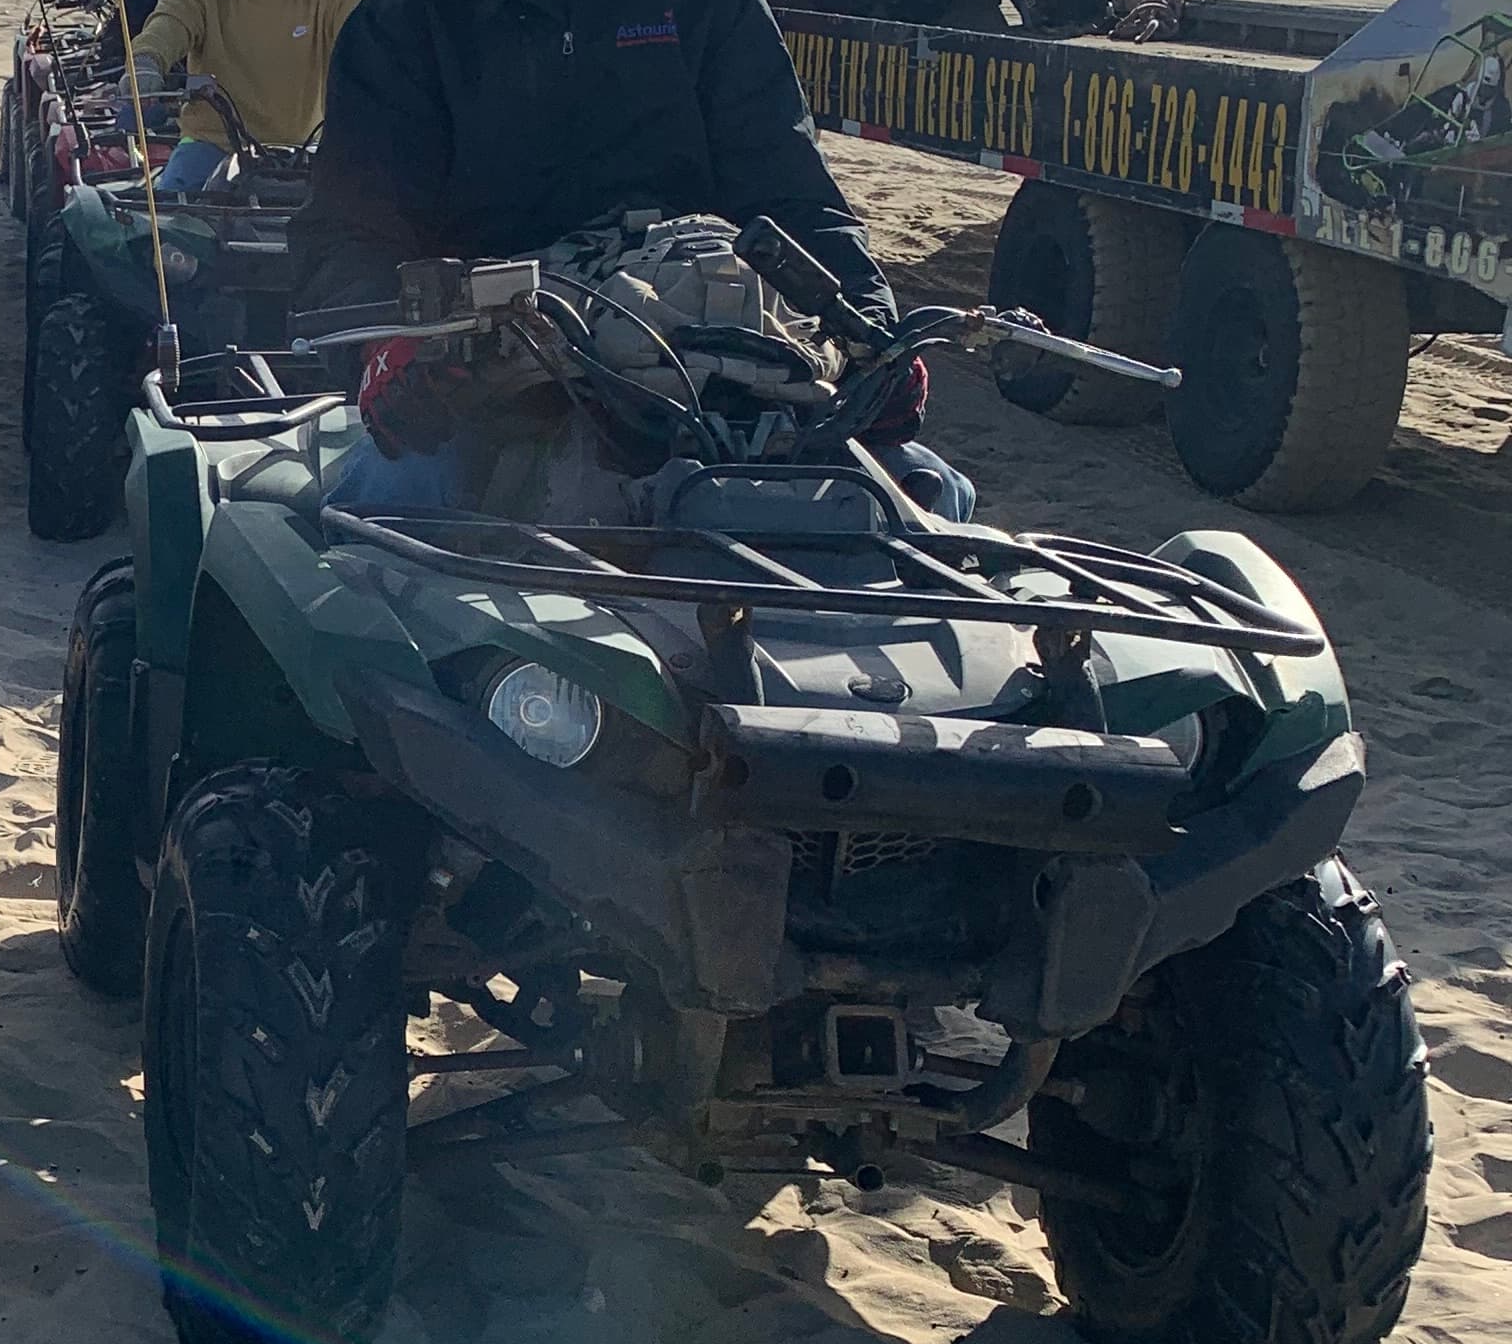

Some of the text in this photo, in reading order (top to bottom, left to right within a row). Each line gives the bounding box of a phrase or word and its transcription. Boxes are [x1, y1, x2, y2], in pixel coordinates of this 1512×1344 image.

[839, 39, 869, 122] THE
[875, 43, 909, 130] FUN
[984, 57, 1036, 156] SETS
[1062, 70, 1287, 215] 1-866-728-4443
